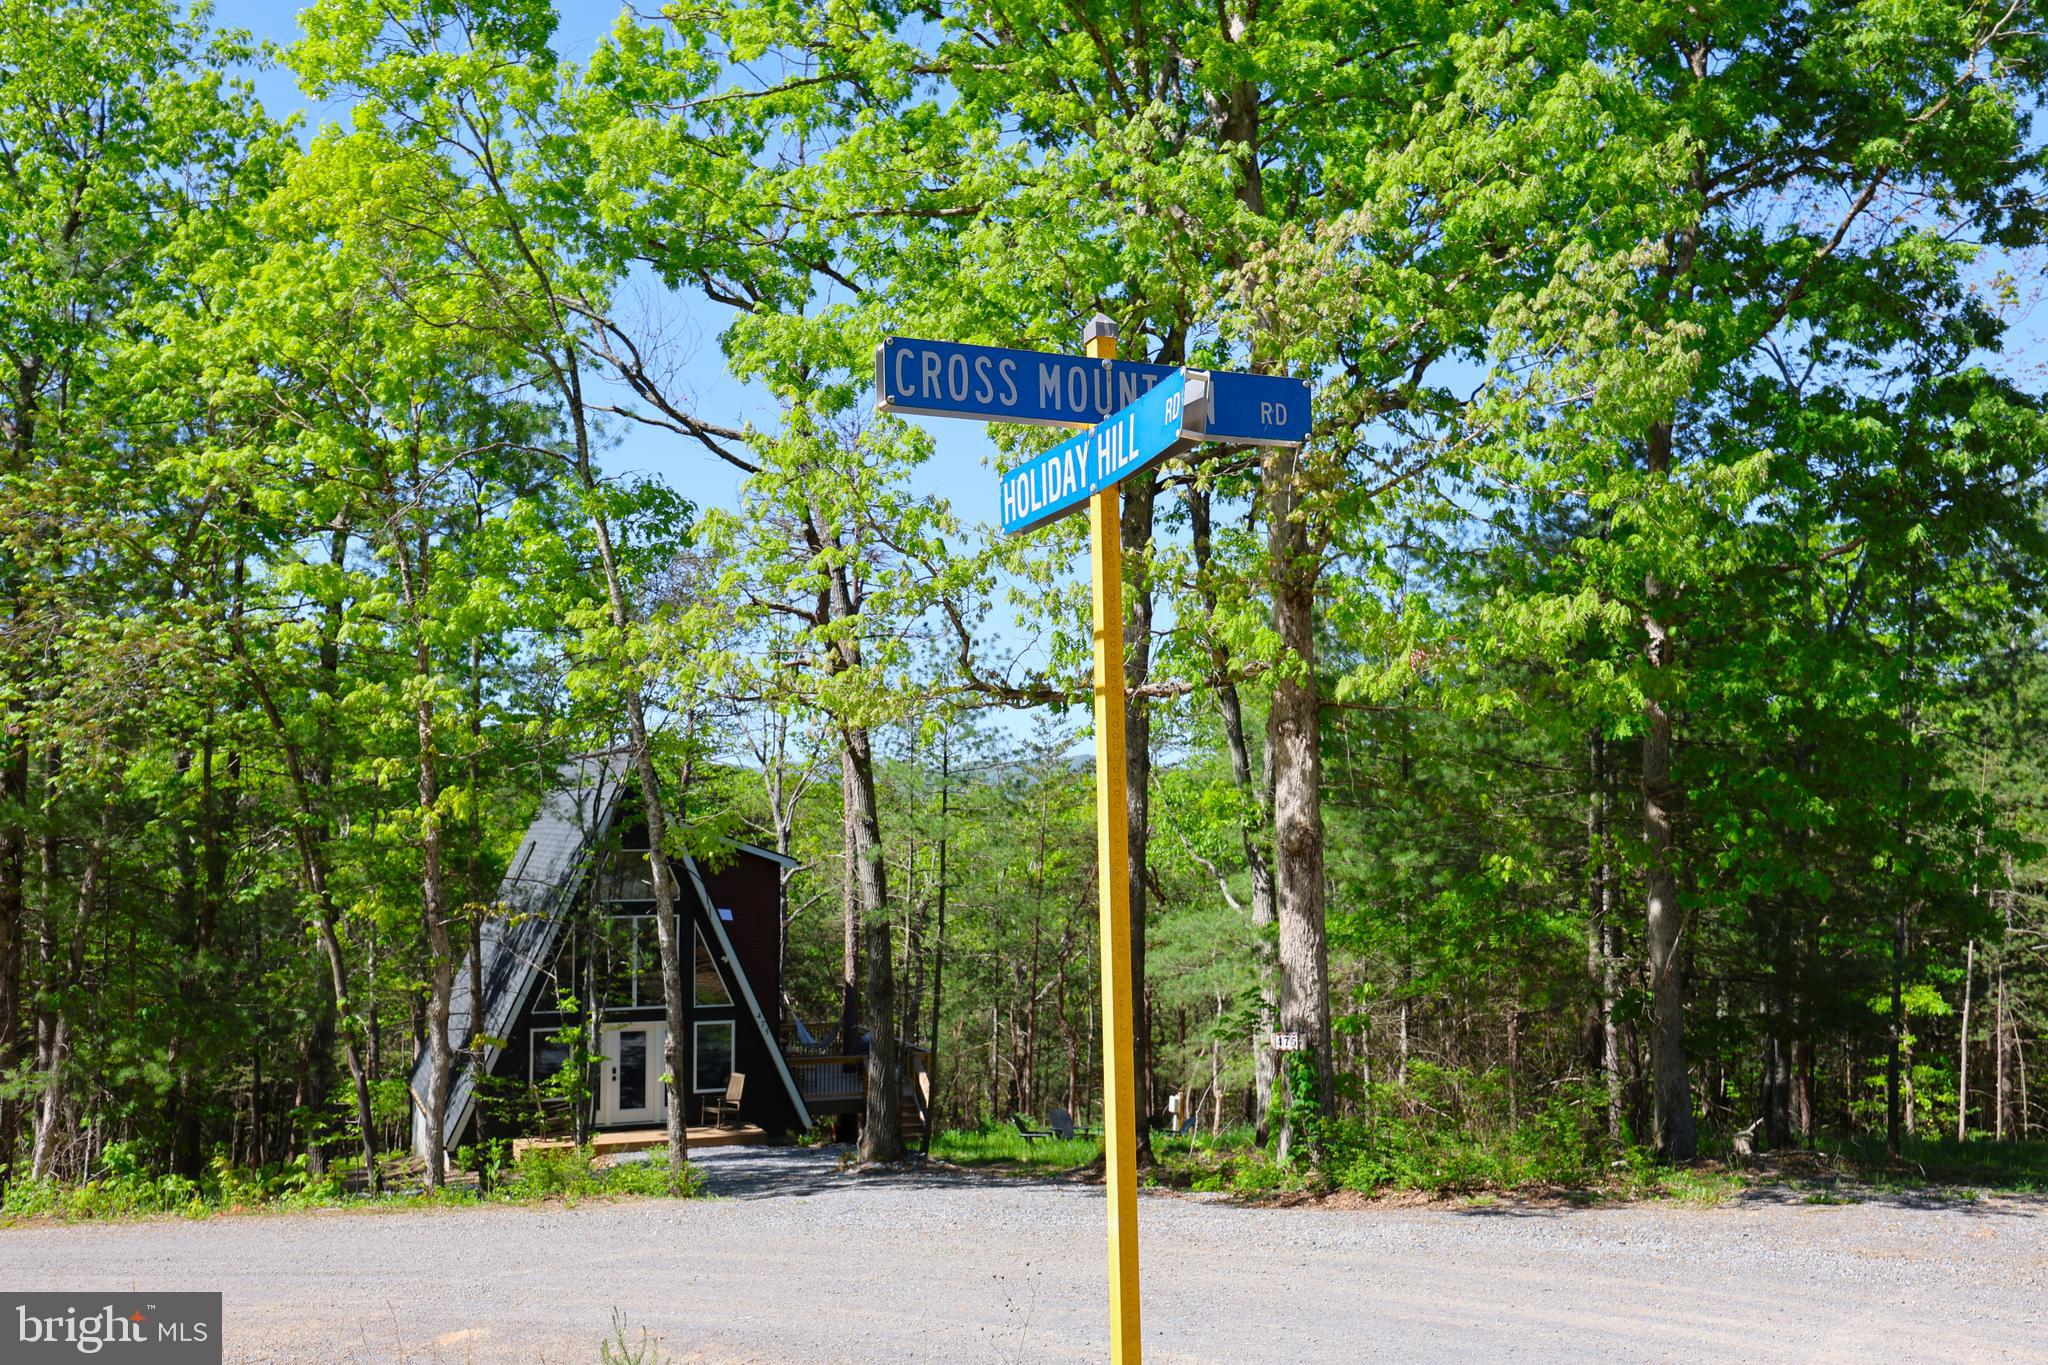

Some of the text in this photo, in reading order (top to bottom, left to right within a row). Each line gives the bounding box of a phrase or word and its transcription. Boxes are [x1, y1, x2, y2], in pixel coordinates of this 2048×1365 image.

[895, 348, 1287, 426] CROSS MOUNTN RD
[1003, 391, 1181, 525] HOLIDAY HILL RD
